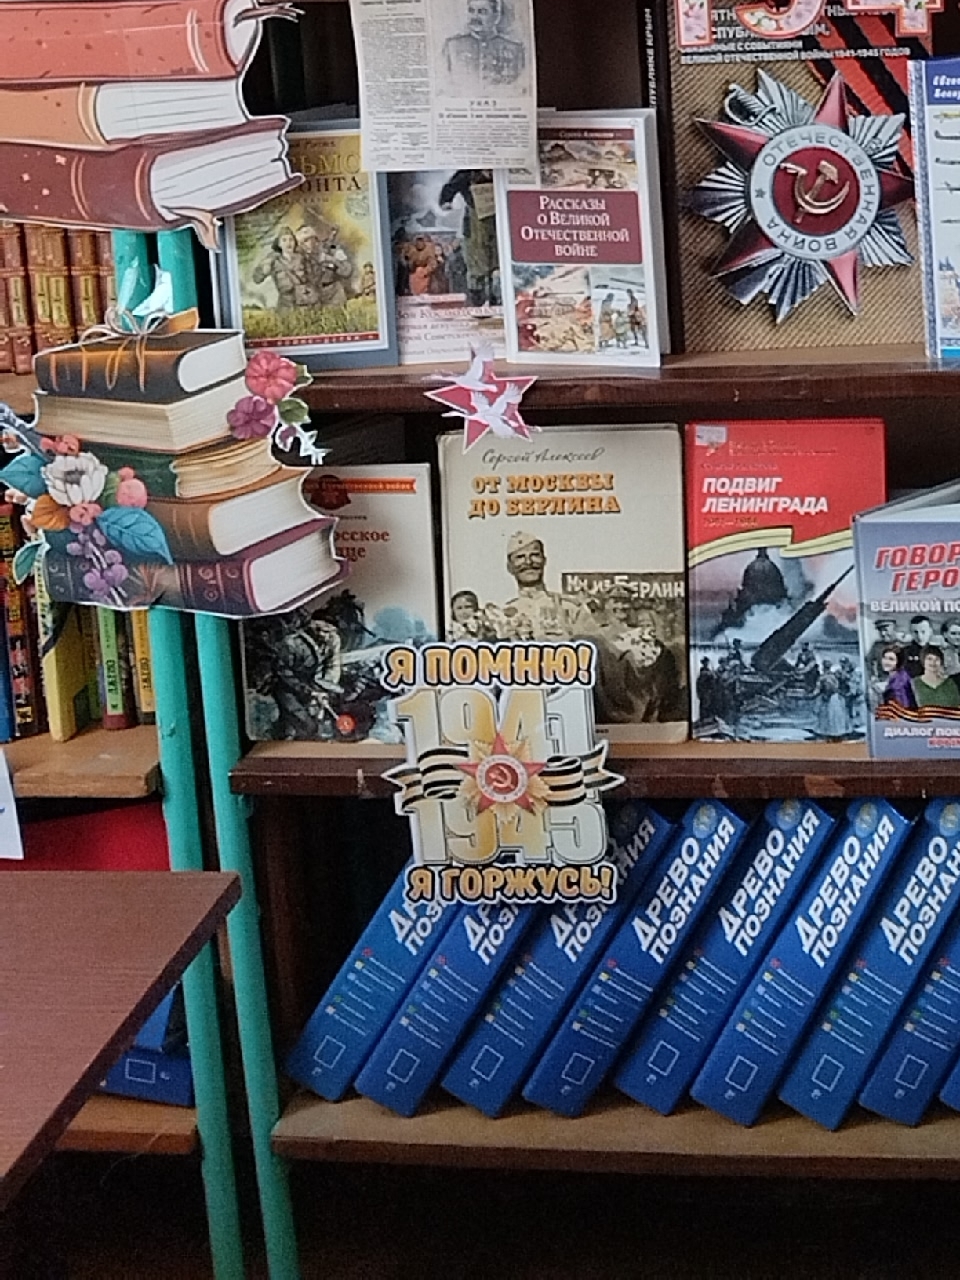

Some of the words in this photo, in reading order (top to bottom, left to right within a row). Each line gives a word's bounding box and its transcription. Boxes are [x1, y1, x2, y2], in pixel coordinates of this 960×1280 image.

[539, 195, 606, 210] РАССКАЗЫ
[521, 226, 629, 242] ОТЕЧЕСТВЕННОЙ
[554, 243, 598, 257] ВОЙНЕ
[472, 475, 501, 493] ОТ
[506, 473, 614, 492] МОСКВЫ
[703, 477, 782, 496] ПОДВИГ
[468, 498, 501, 520] ДО
[506, 496, 621, 516] БЕРЛИНА
[702, 496, 828, 515] ЛЕНИНГРАДА
[871, 598, 942, 613] ВЕЛИКОЙ
[386, 647, 416, 685] Я
[423, 644, 594, 686] ПОМНЮ!
[396, 687, 596, 756] 1941
[884, 727, 933, 737] ДИАЛОГ
[413, 801, 608, 864] 1945
[407, 867, 435, 902] Я
[441, 866, 615, 903] ГОРЖУСЬ!
[632, 837, 700, 952] ДРЕВО
[649, 815, 736, 964] ПОЗНАНИЯ
[718, 828, 784, 943] ДРЕВО
[733, 808, 820, 956] ПОЗНАНИЯ
[796, 835, 861, 954] ДРЕВО
[810, 815, 894, 968] ПОЗНАНИЯ
[880, 836, 947, 953] ДРЕВО
